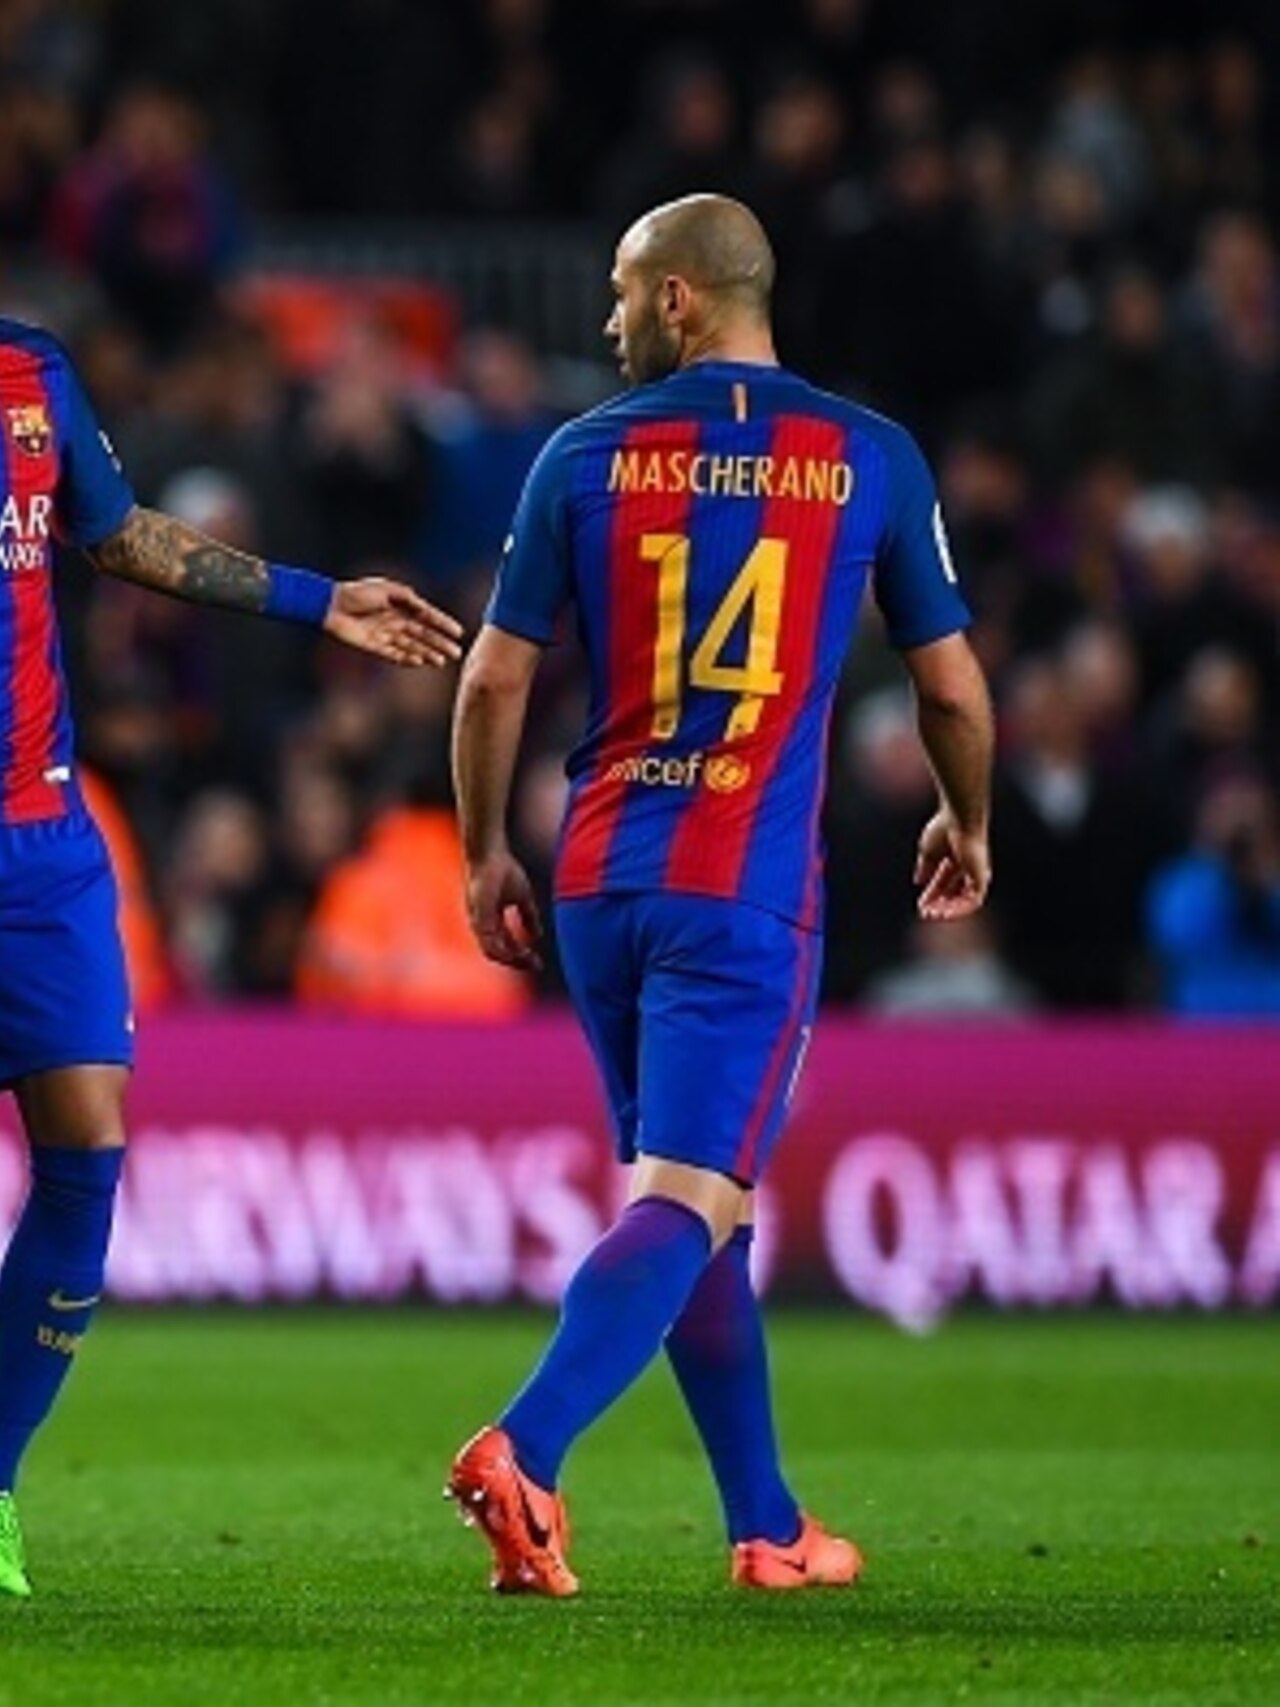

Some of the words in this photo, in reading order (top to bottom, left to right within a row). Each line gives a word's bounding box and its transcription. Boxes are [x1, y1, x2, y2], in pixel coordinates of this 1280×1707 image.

[606, 450, 854, 506] MASCHERANO
[640, 534, 789, 742] 14
[823, 1132, 1232, 1338] QATAR
